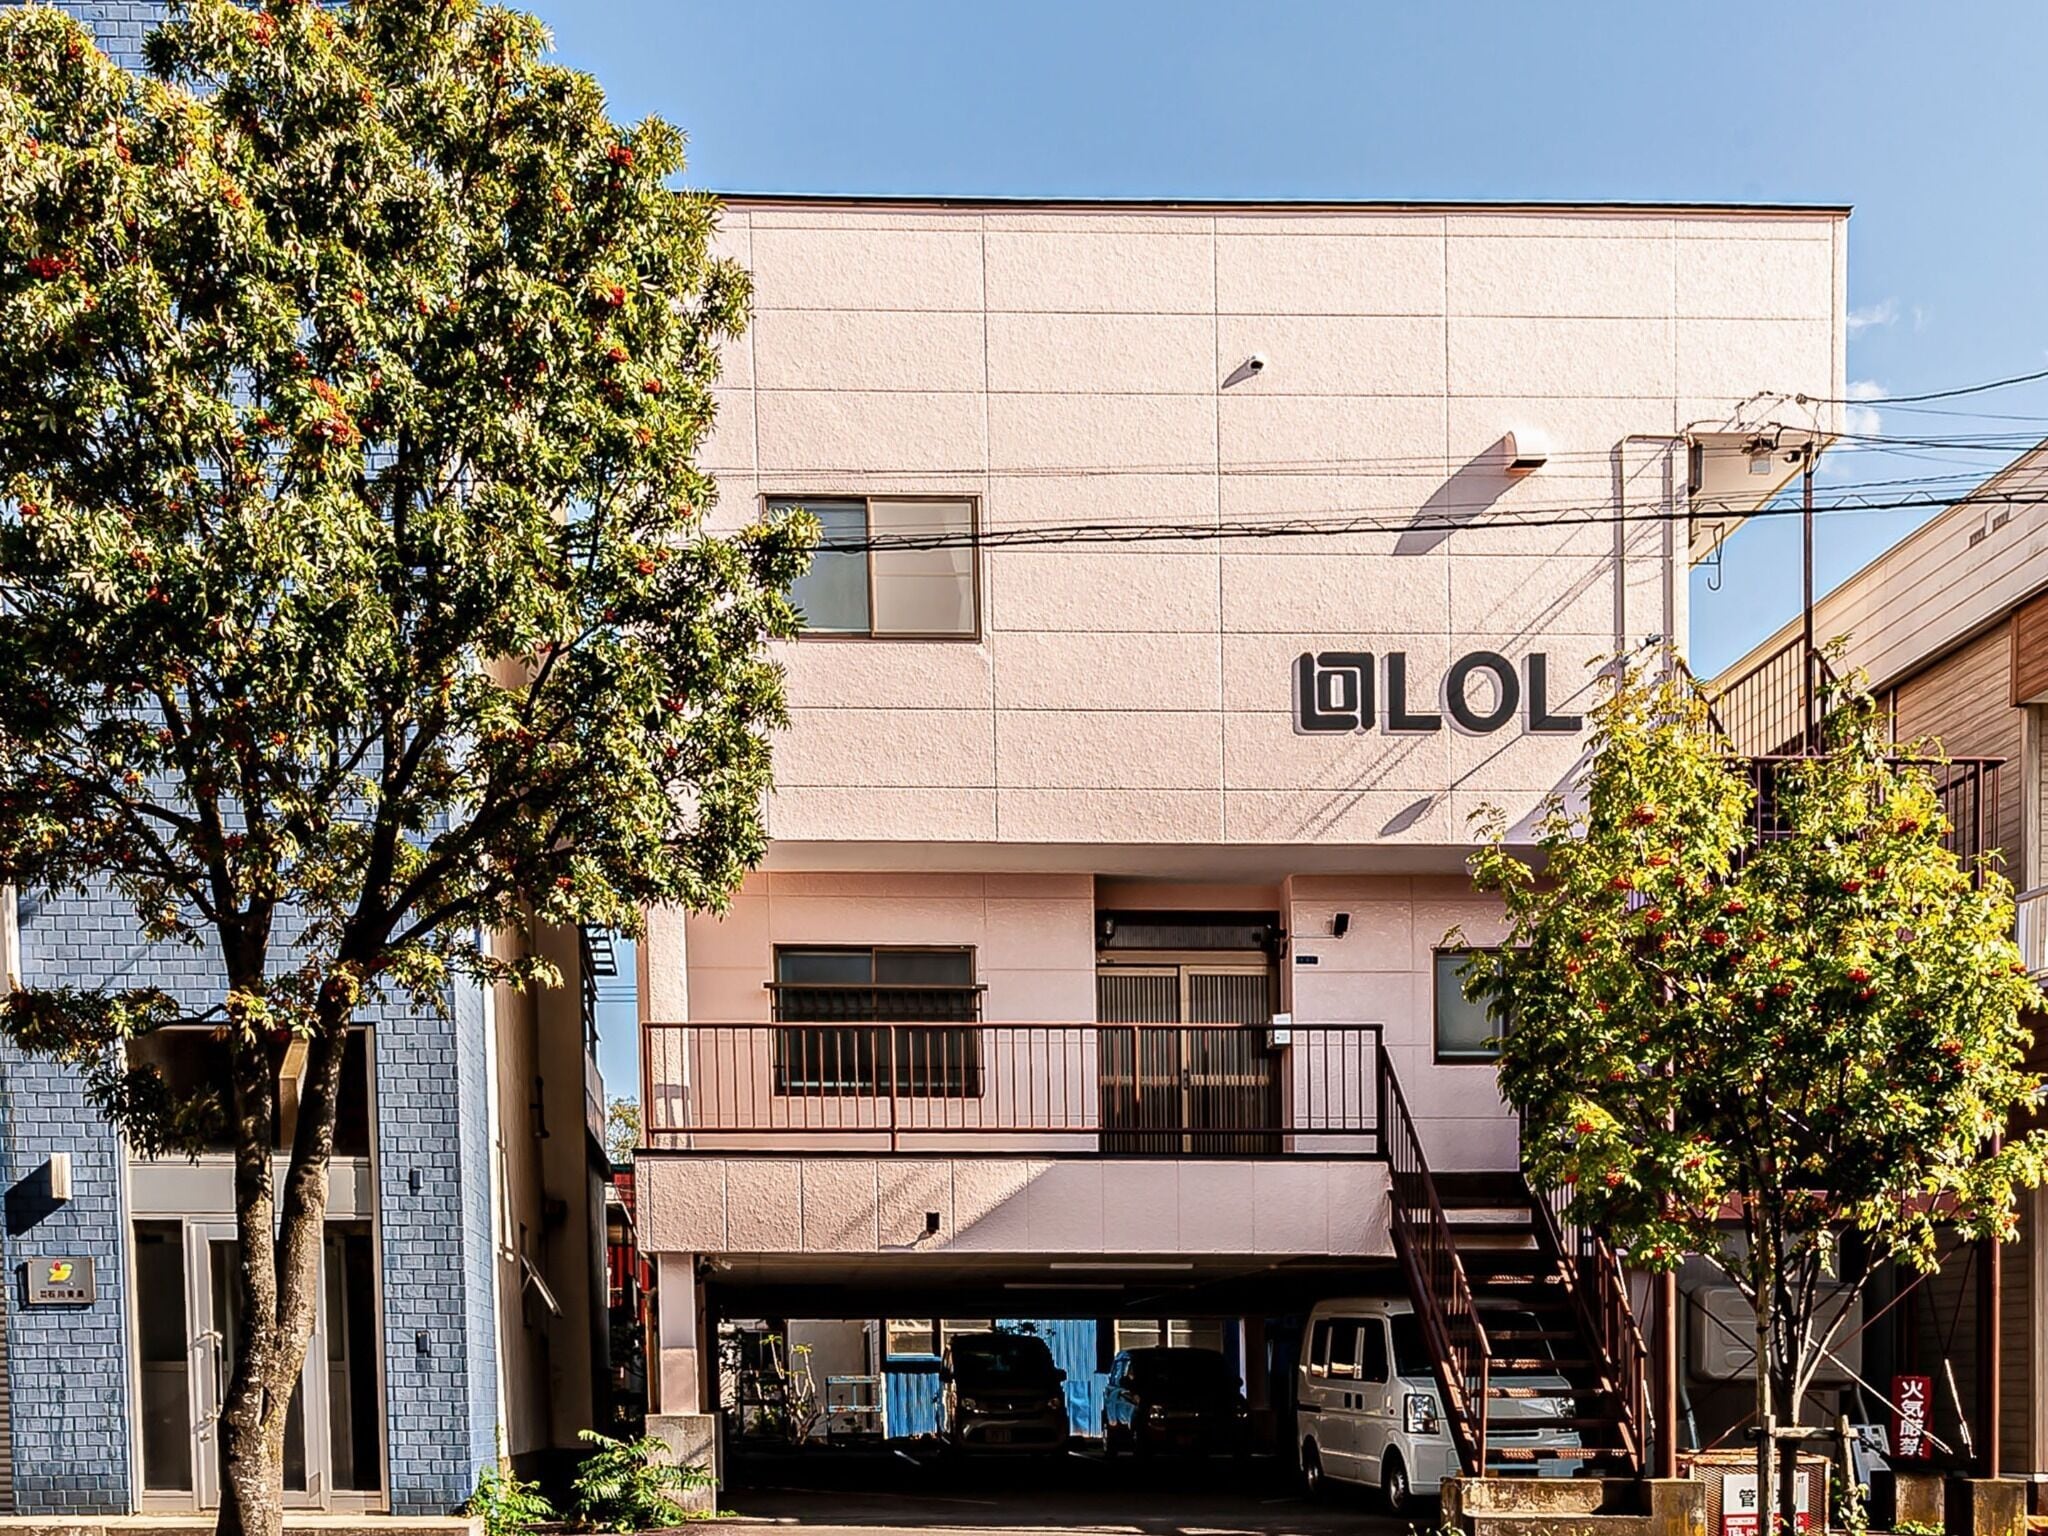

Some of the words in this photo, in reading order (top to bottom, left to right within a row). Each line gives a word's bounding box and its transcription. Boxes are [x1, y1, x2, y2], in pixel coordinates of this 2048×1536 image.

[1388, 650, 1583, 732] LOL
[1899, 1379, 1925, 1457] 火気厳禁
